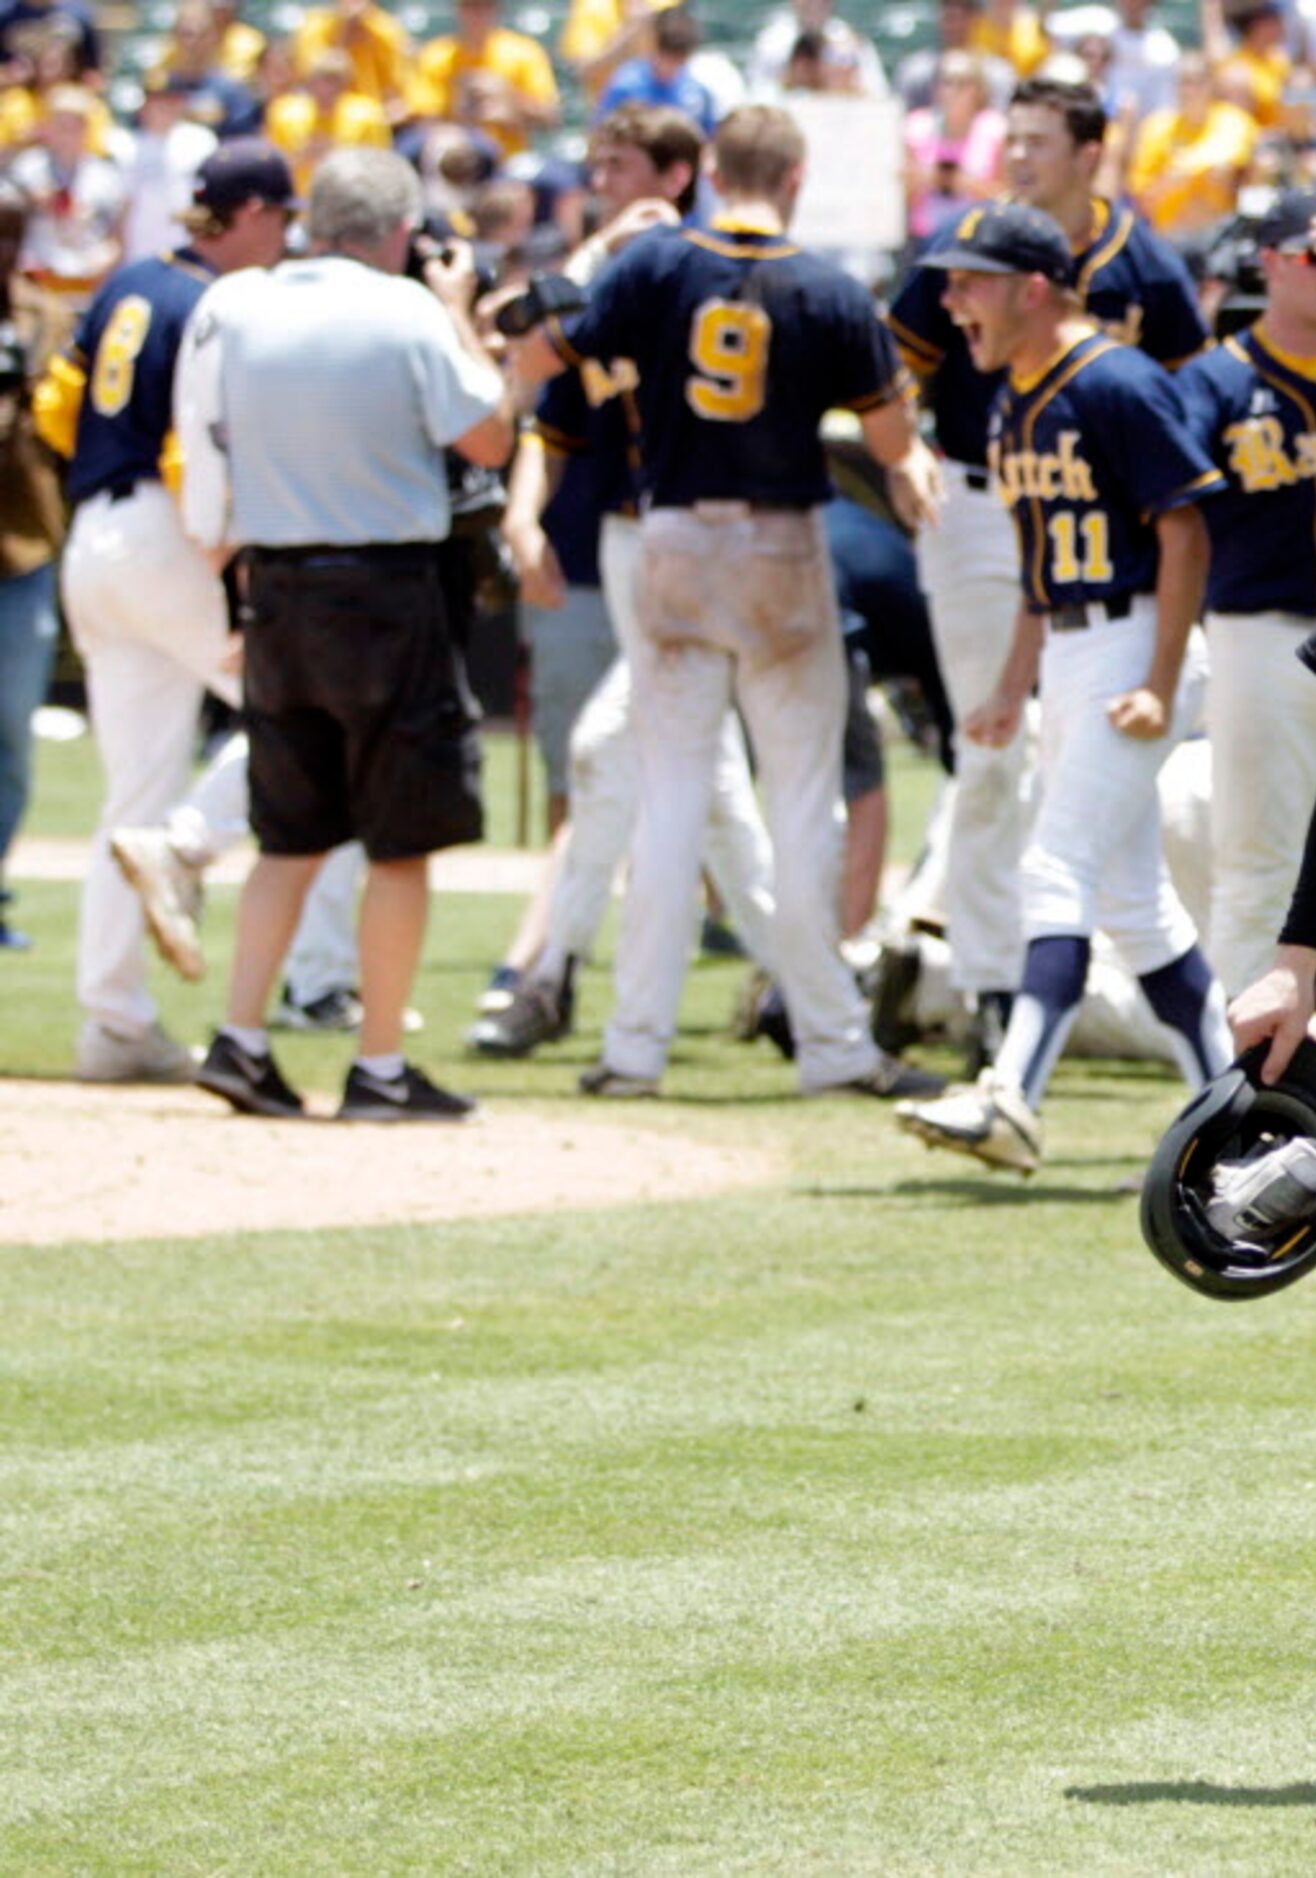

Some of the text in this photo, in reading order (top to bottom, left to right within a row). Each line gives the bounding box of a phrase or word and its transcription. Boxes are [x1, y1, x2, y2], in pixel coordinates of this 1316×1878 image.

[90, 293, 152, 418] 8
[685, 297, 772, 421] 9
[1048, 511, 1114, 584] 11
